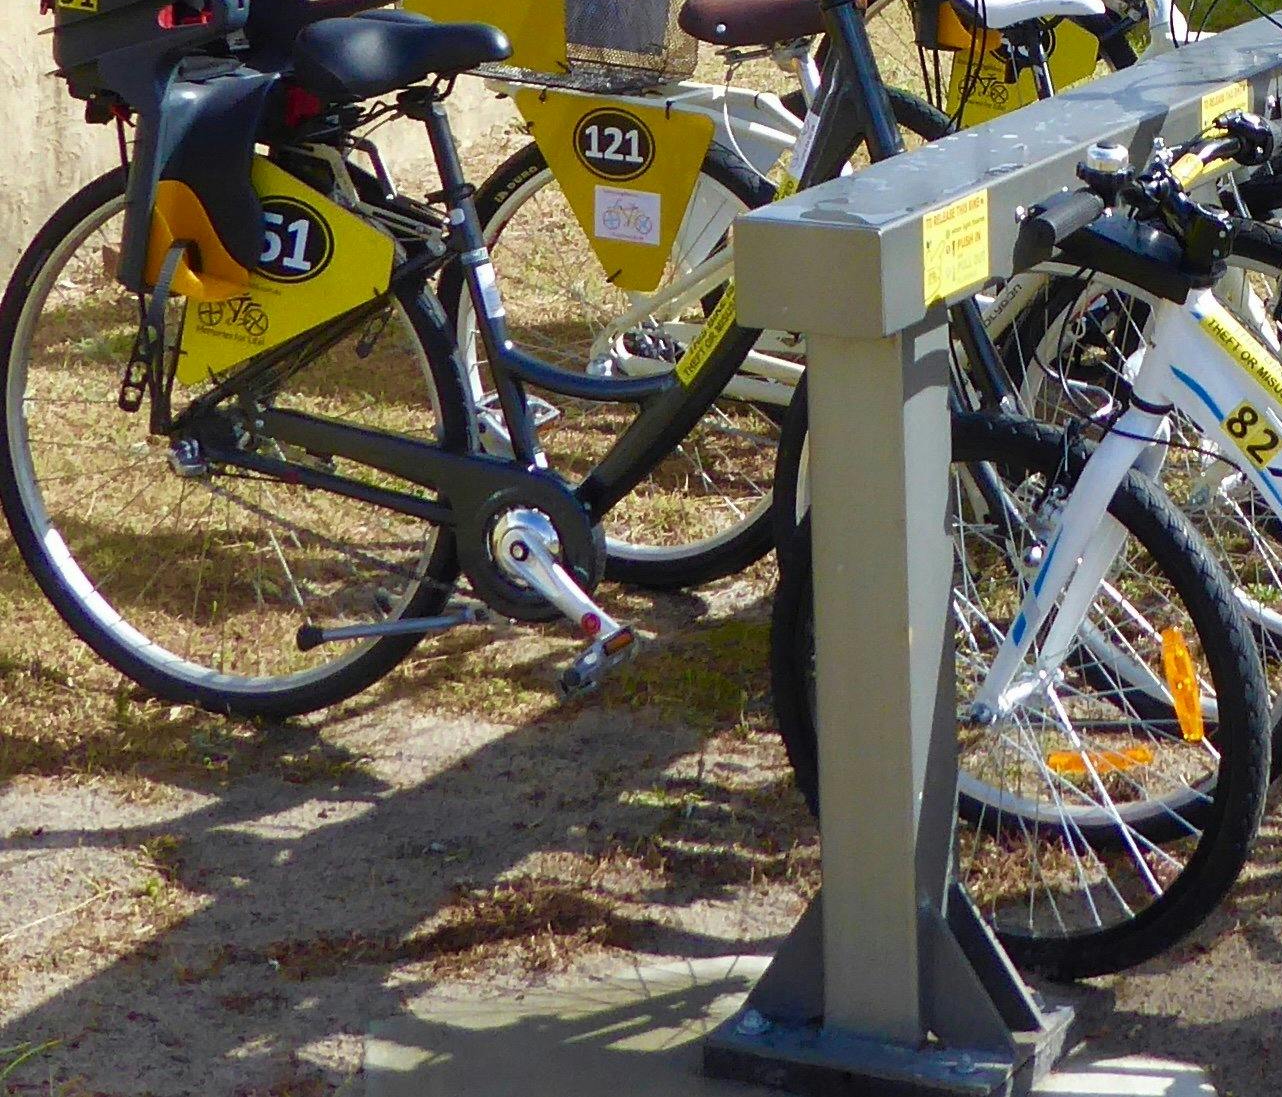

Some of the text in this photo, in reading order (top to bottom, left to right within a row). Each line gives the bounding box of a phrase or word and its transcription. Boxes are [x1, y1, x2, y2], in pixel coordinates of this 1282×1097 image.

[585, 125, 644, 163] 121
[260, 212, 312, 271] 51
[1208, 320, 1242, 352] THEFT
[1240, 350, 1258, 370] OR
[1226, 406, 1279, 464] 82
